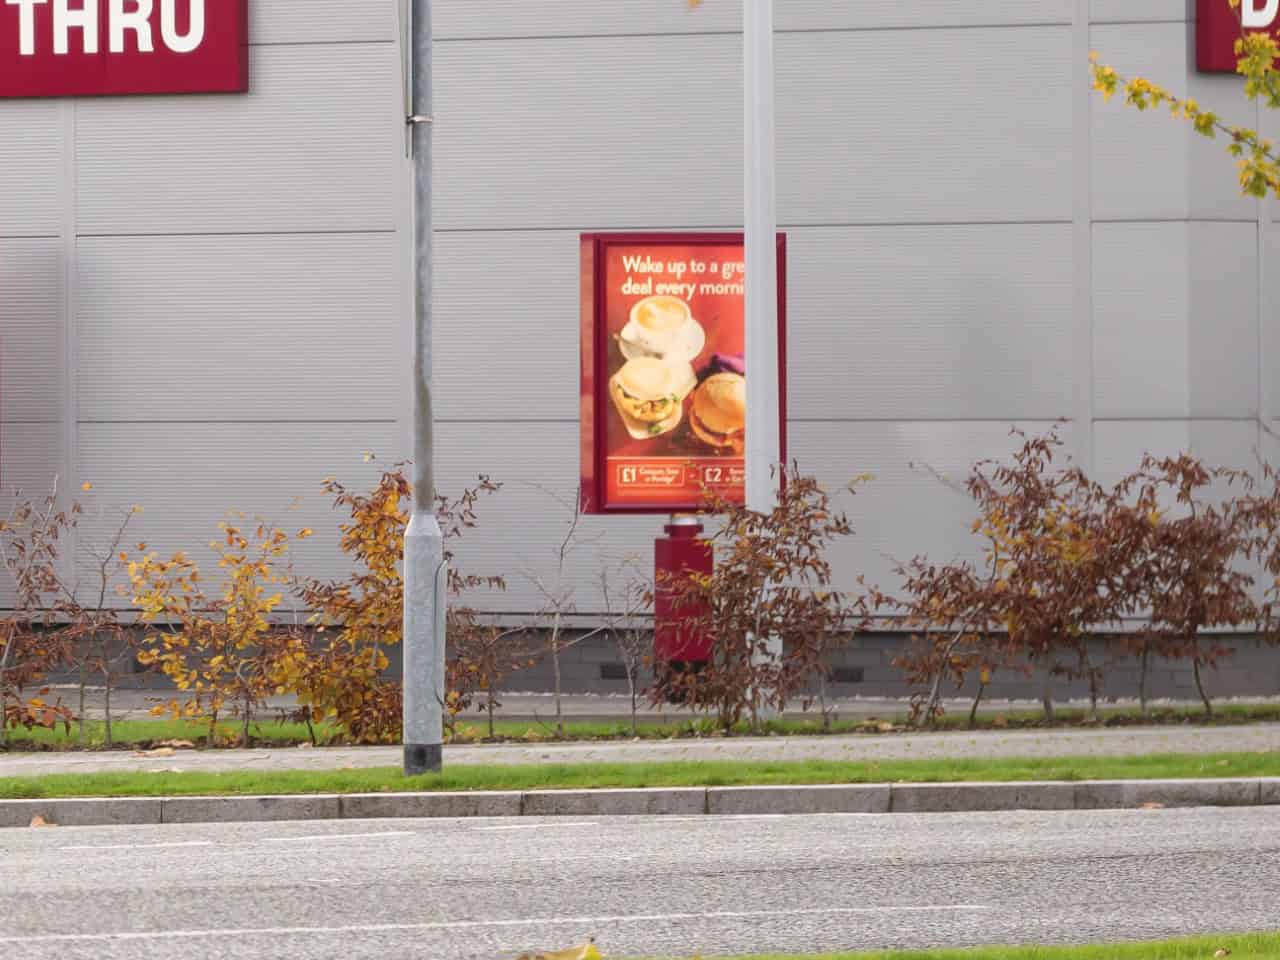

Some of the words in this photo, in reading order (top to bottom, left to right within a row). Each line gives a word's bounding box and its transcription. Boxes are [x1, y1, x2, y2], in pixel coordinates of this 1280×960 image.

[622, 255, 663, 273] Wake
[668, 260, 686, 279] up
[690, 258, 705, 273] to
[710, 262, 717, 273] a
[722, 261, 745, 279] gre
[621, 278, 652, 295] deal
[655, 282, 696, 299] every
[700, 279, 745, 295] morni
[623, 468, 636, 482] £1
[705, 467, 721, 482] £2
